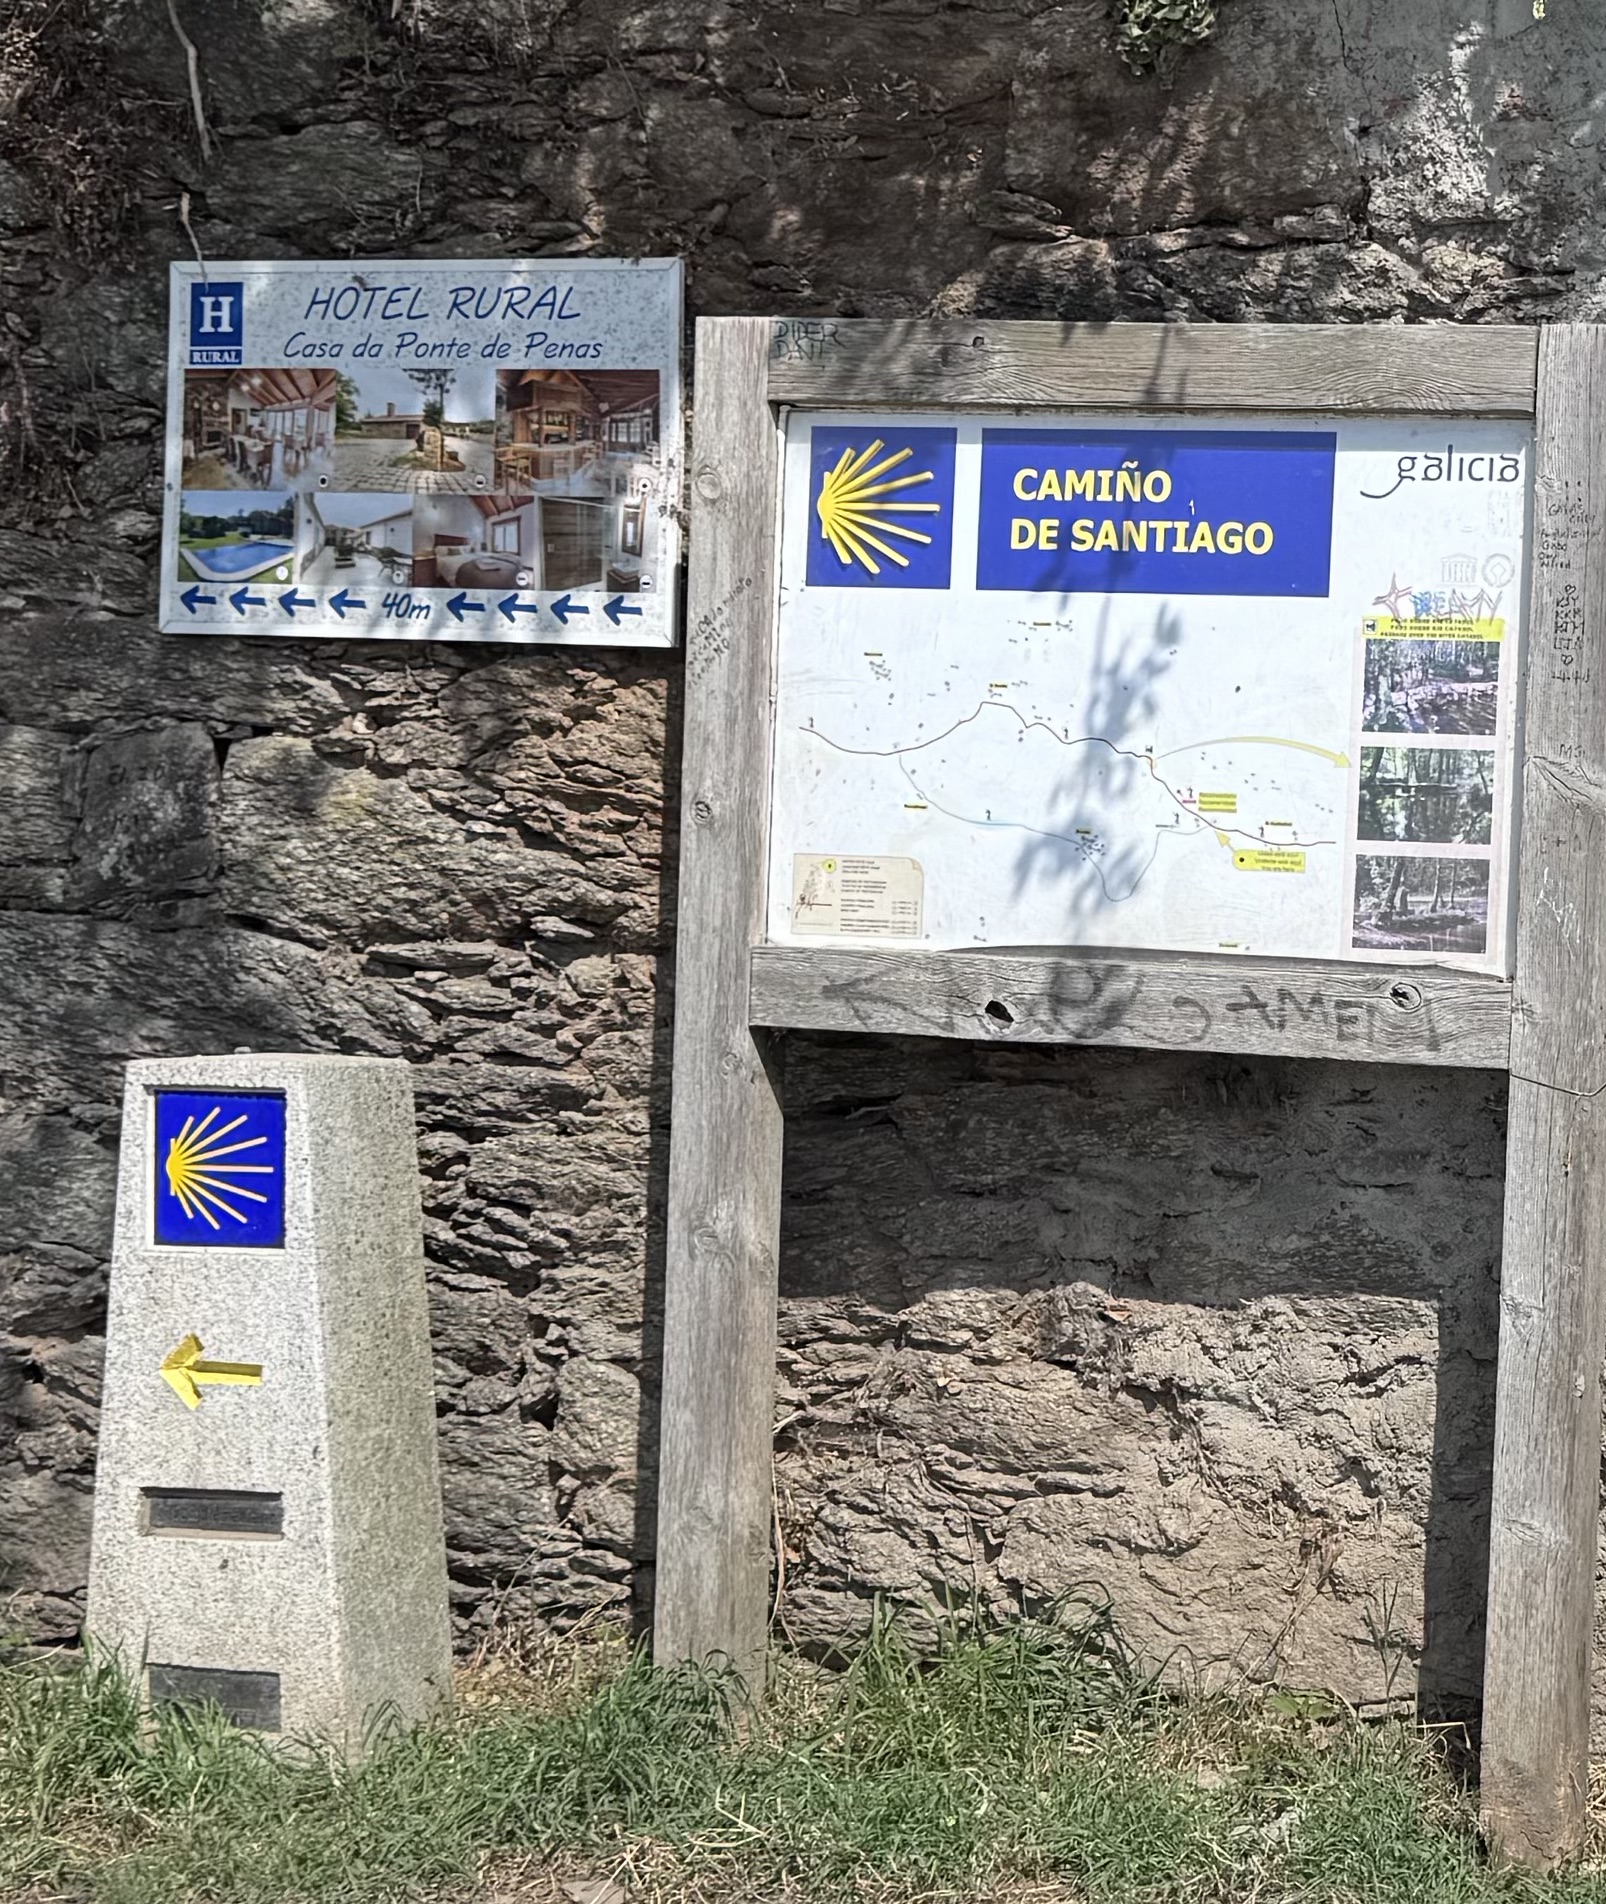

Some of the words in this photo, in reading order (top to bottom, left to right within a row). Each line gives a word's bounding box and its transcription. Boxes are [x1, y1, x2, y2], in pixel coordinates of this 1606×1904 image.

[199, 296, 234, 333] H
[304, 286, 430, 321] HOTEL
[446, 285, 581, 321] RURAL
[192, 351, 240, 363] RURAL
[283, 331, 344, 358] Casa
[352, 332, 384, 358] da
[395, 331, 472, 359] Ponte
[480, 332, 511, 359] de
[524, 331, 603, 359] Penas
[1013, 460, 1172, 504] CAMIÑO
[1360, 444, 1520, 499] galicia
[1010, 518, 1060, 551] DE
[1070, 518, 1274, 555] SANTIAGO
[381, 592, 431, 620] 40m
